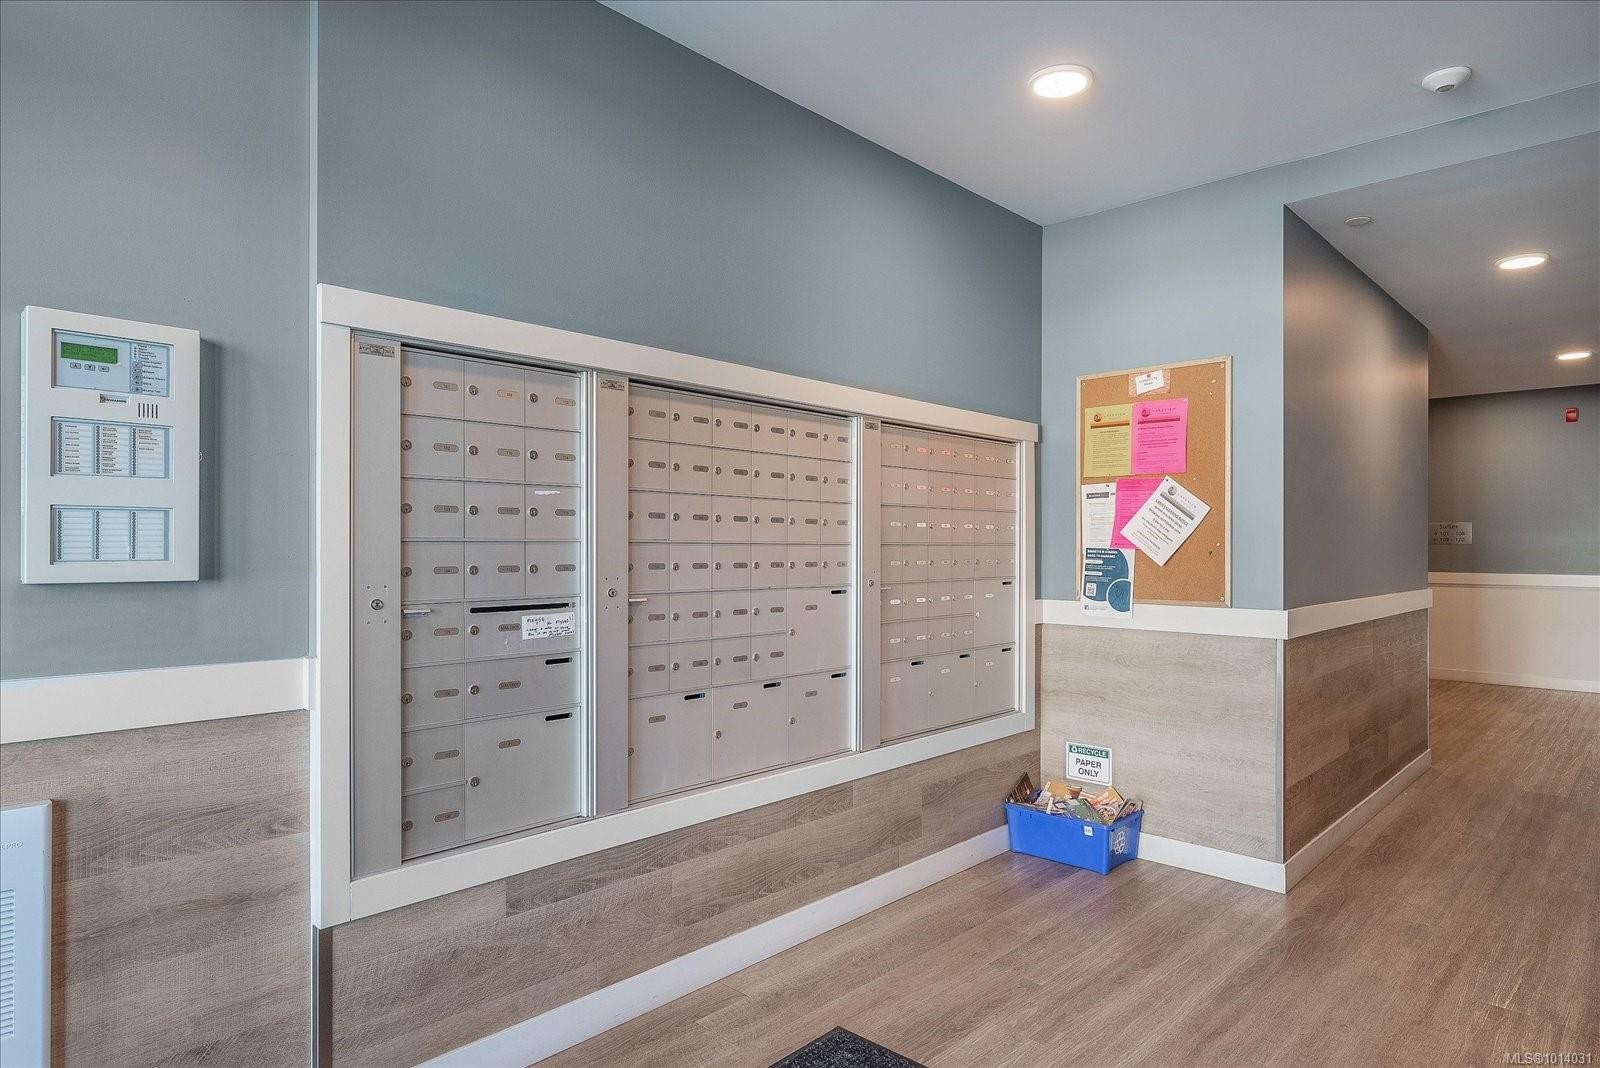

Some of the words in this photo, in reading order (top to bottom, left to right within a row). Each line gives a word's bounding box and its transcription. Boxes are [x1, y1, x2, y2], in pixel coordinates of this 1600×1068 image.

[1078, 747, 1107, 758] RECYCLE
[1075, 758, 1102, 769] PAPER
[1078, 767, 1099, 778] ONLY
